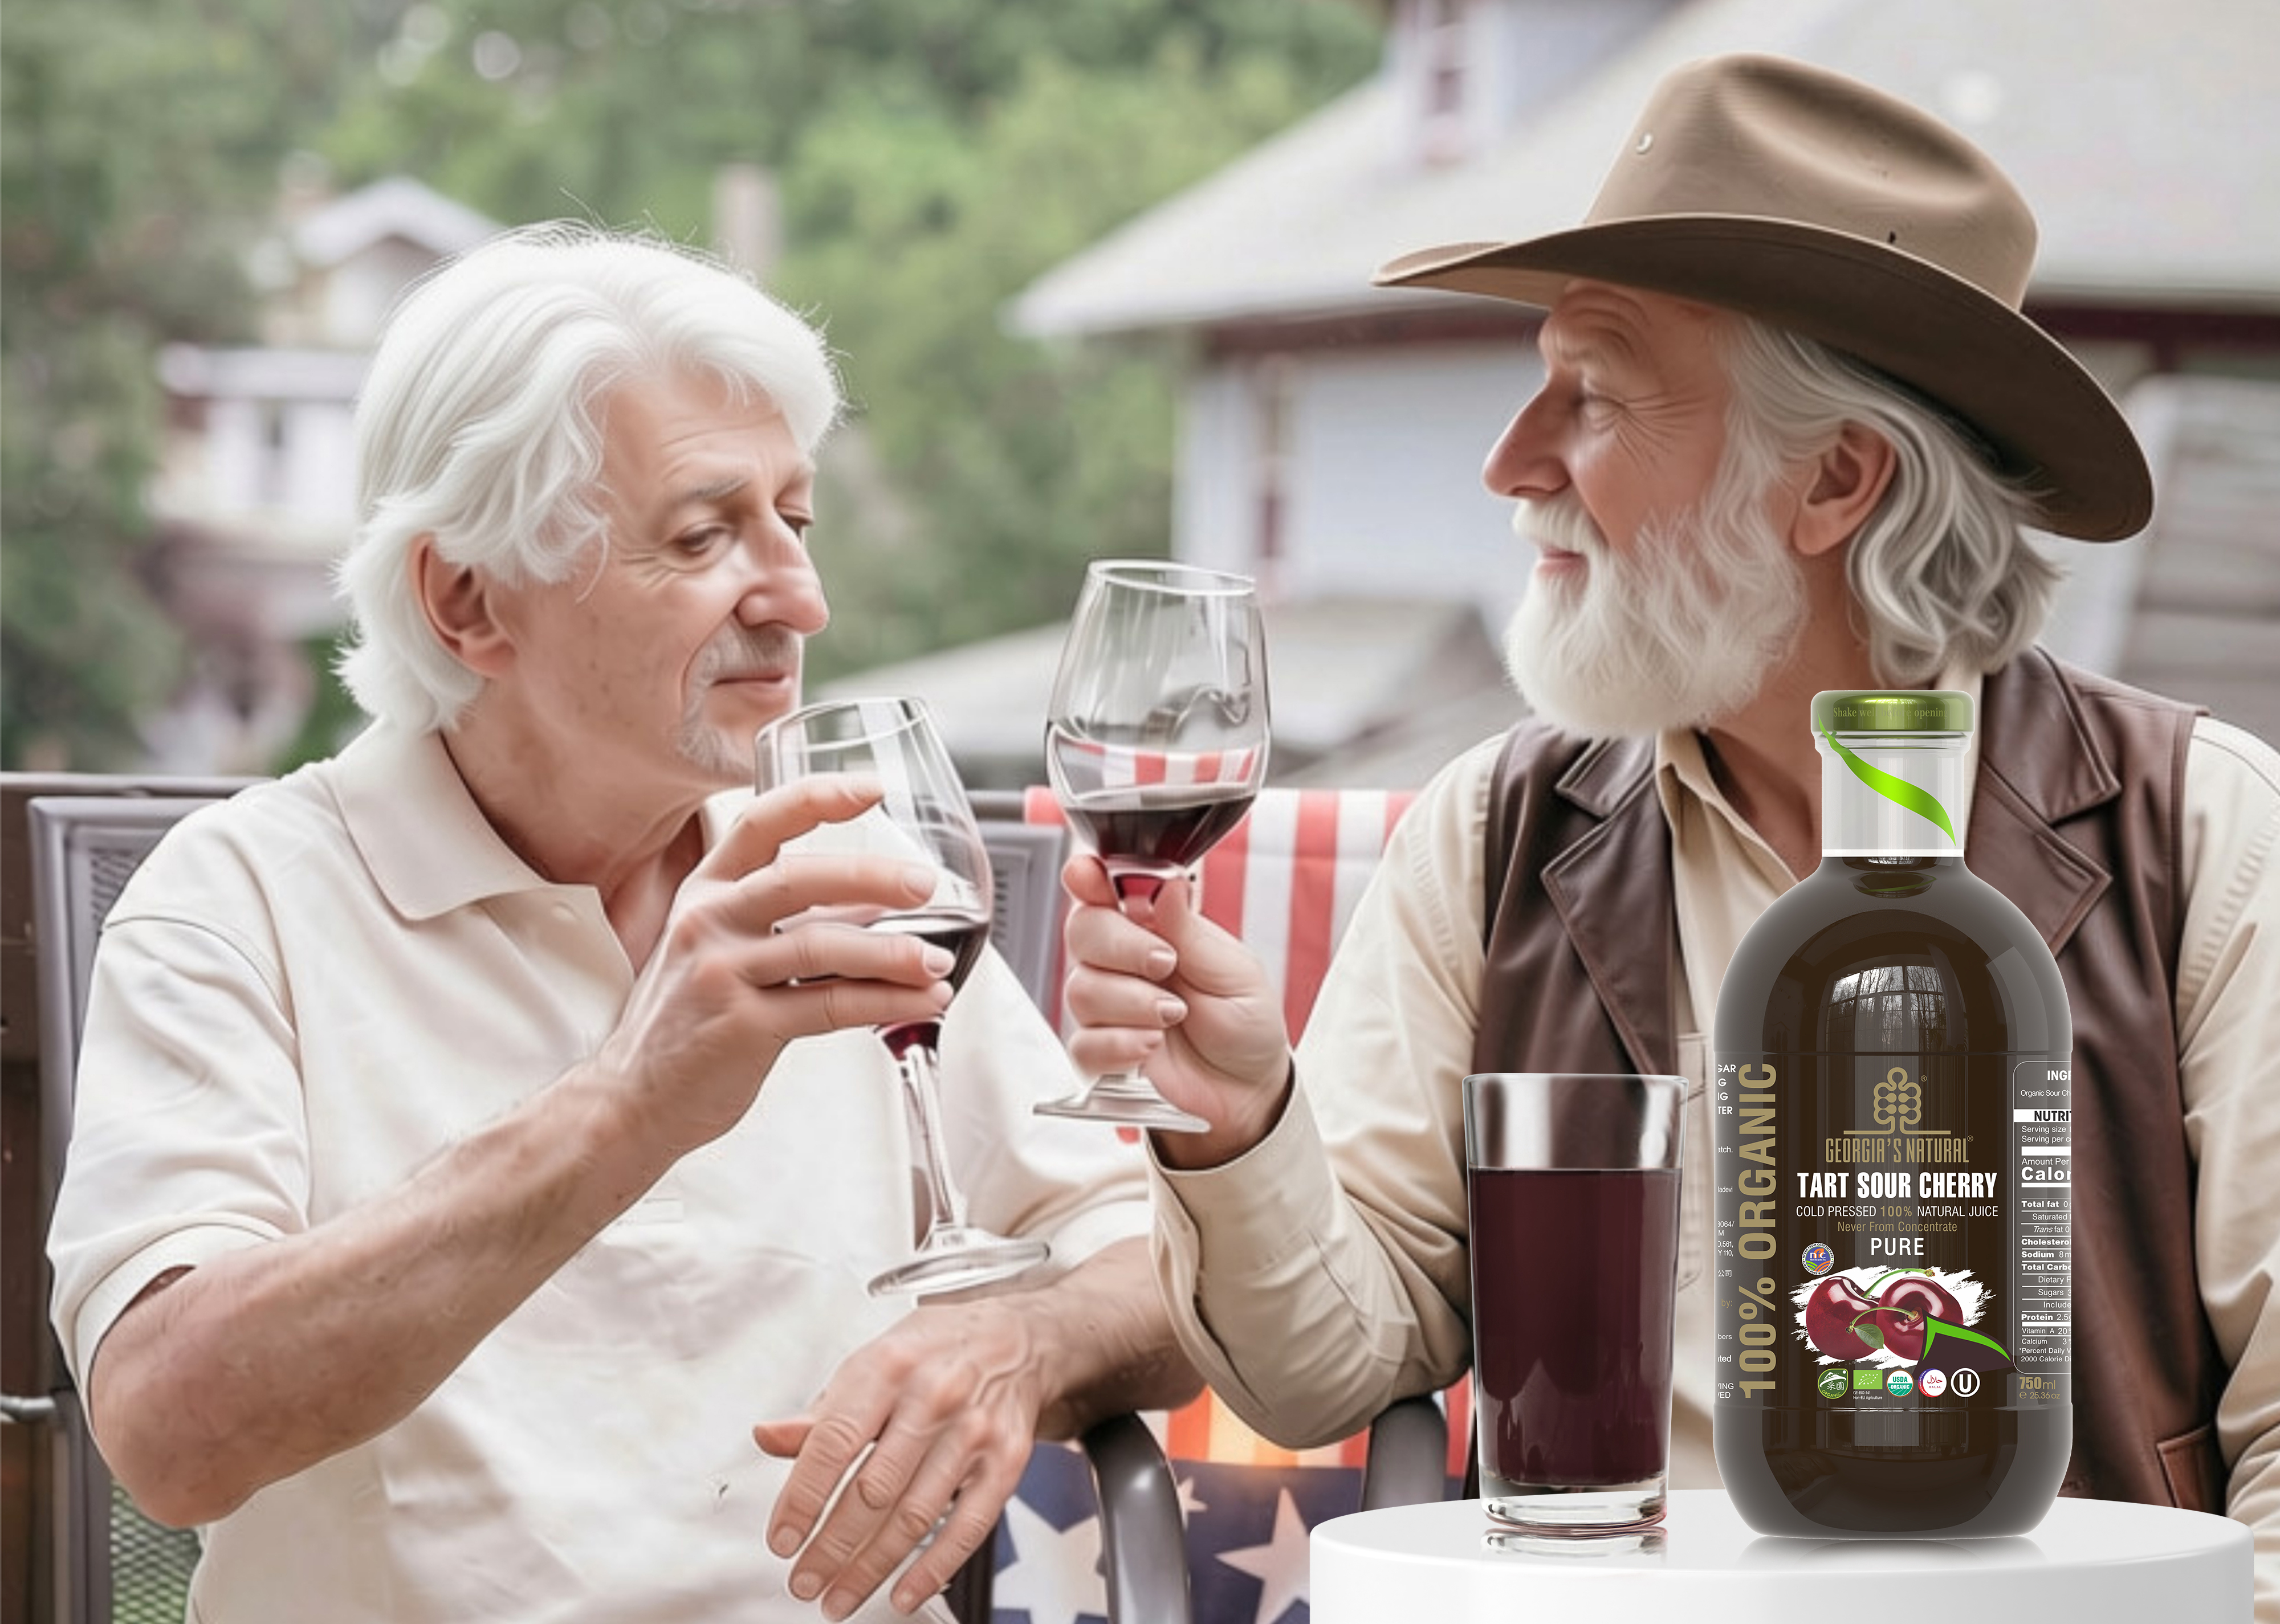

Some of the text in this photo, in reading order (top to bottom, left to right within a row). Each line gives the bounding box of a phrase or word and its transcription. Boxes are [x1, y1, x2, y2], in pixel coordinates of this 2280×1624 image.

[1833, 707, 1857, 717] Shake
[1914, 708, 1948, 720] opening
[2021, 1090, 2045, 1098] Organic
[2034, 1111, 2071, 1121] NUTRI
[2021, 1125, 2050, 1135] Serving
[2021, 1136, 2050, 1144] Serving
[1797, 1172, 1997, 1198] TART SOUR CHERRY
[1796, 1205, 1998, 1217] COLD PRESSED 100% NATURAL JUICE
[1738, 1063, 1777, 1399] 100% ORGANIC
[1838, 1222, 1957, 1232] Never From Concentrate
[1871, 1237, 1924, 1256] PURE
[2038, 1276, 2065, 1284] Dietary
[2038, 1289, 2064, 1297] Sugars
